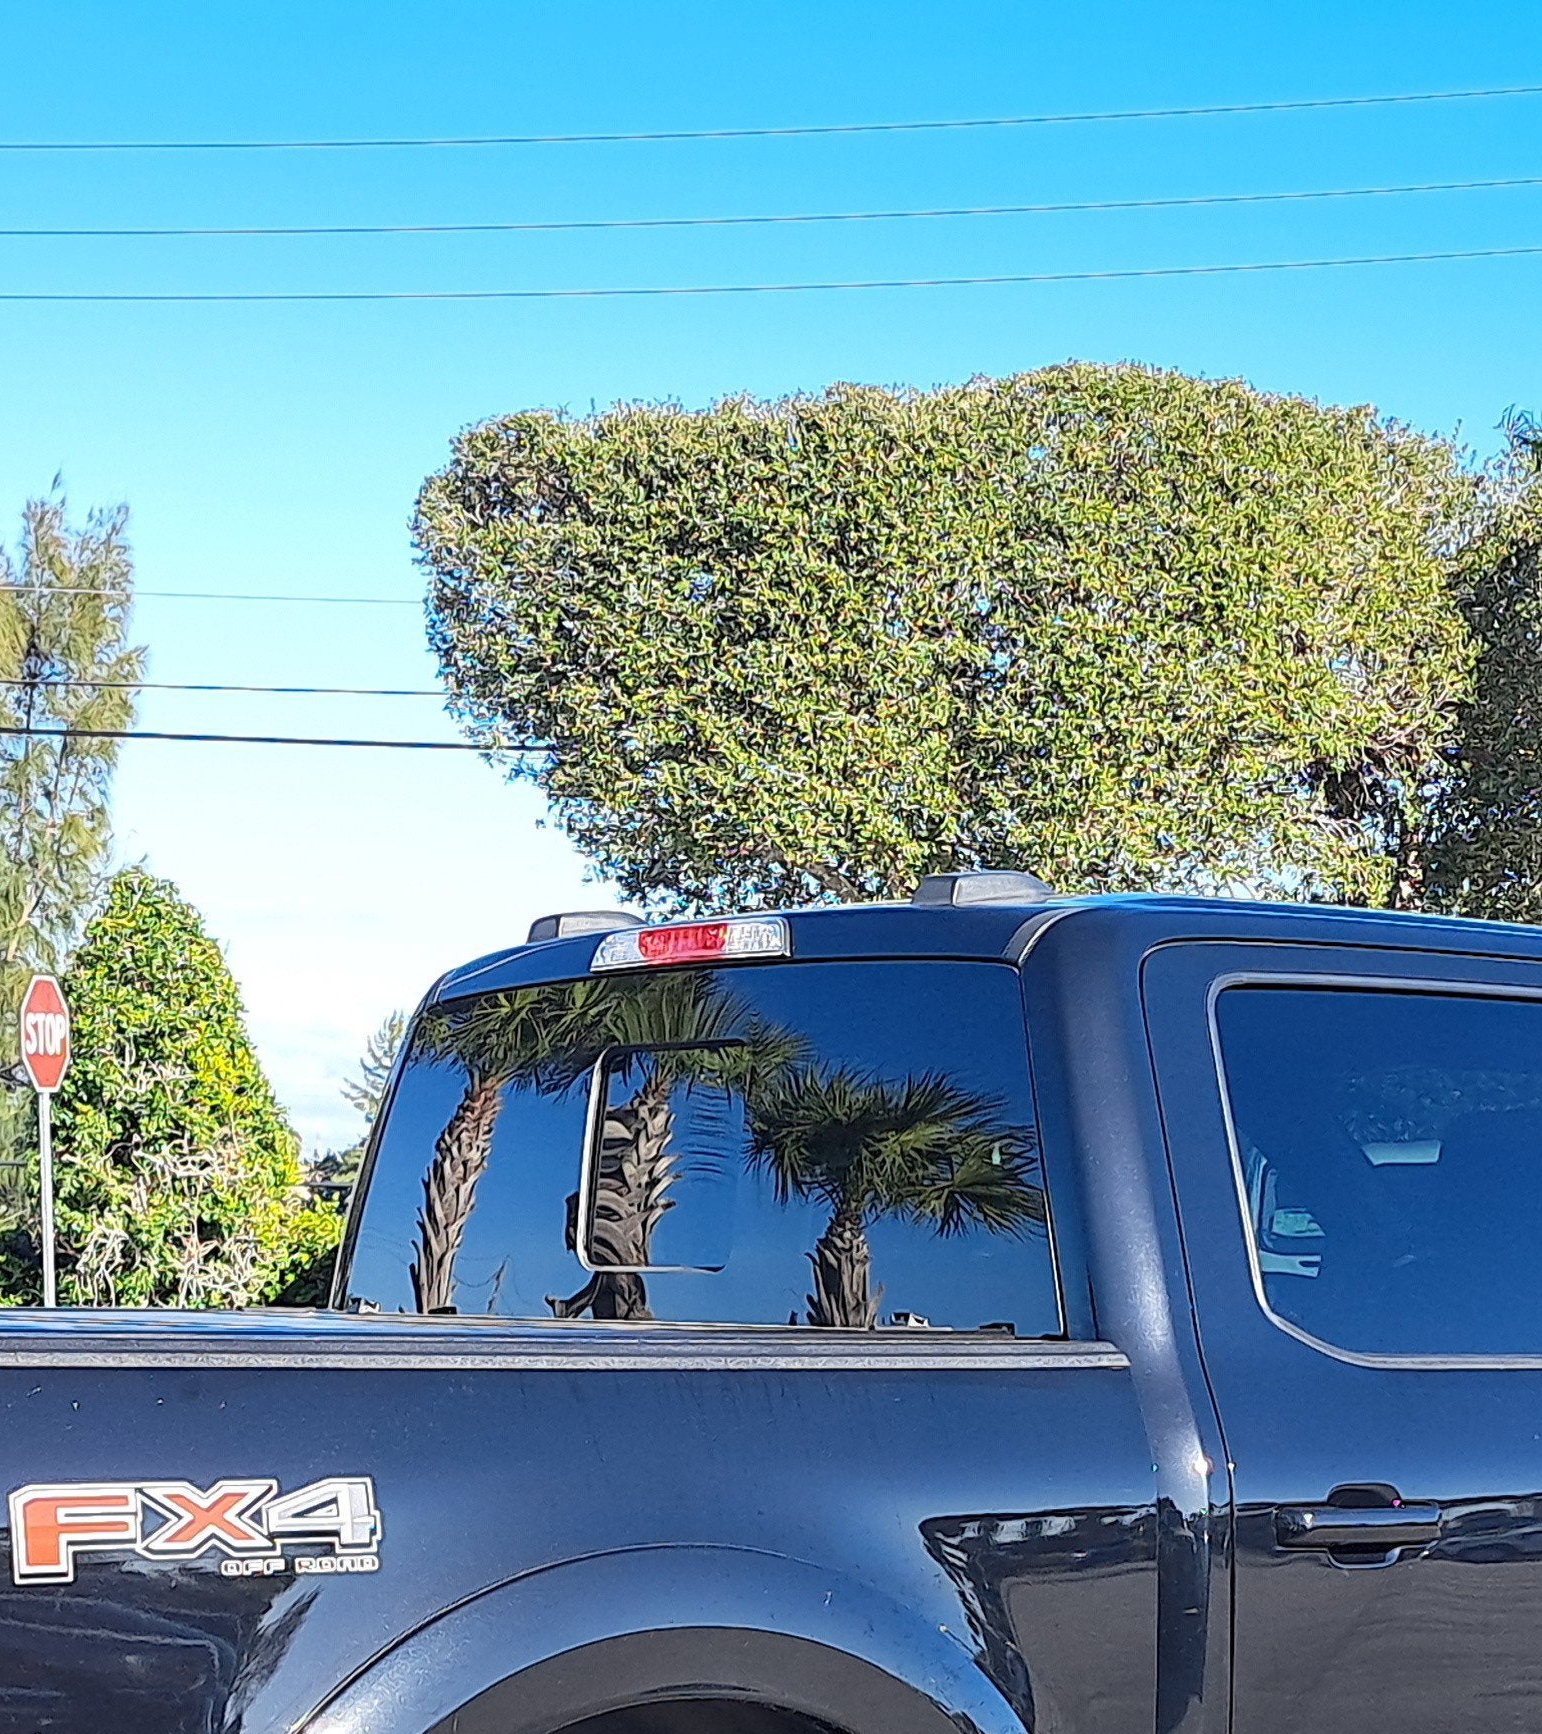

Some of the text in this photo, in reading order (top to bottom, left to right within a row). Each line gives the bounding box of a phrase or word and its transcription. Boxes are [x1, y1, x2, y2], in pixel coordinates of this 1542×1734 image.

[25, 1012, 66, 1056] STOP
[8, 1476, 383, 1586] FX4
[221, 1553, 381, 1577] OFF ROAD
